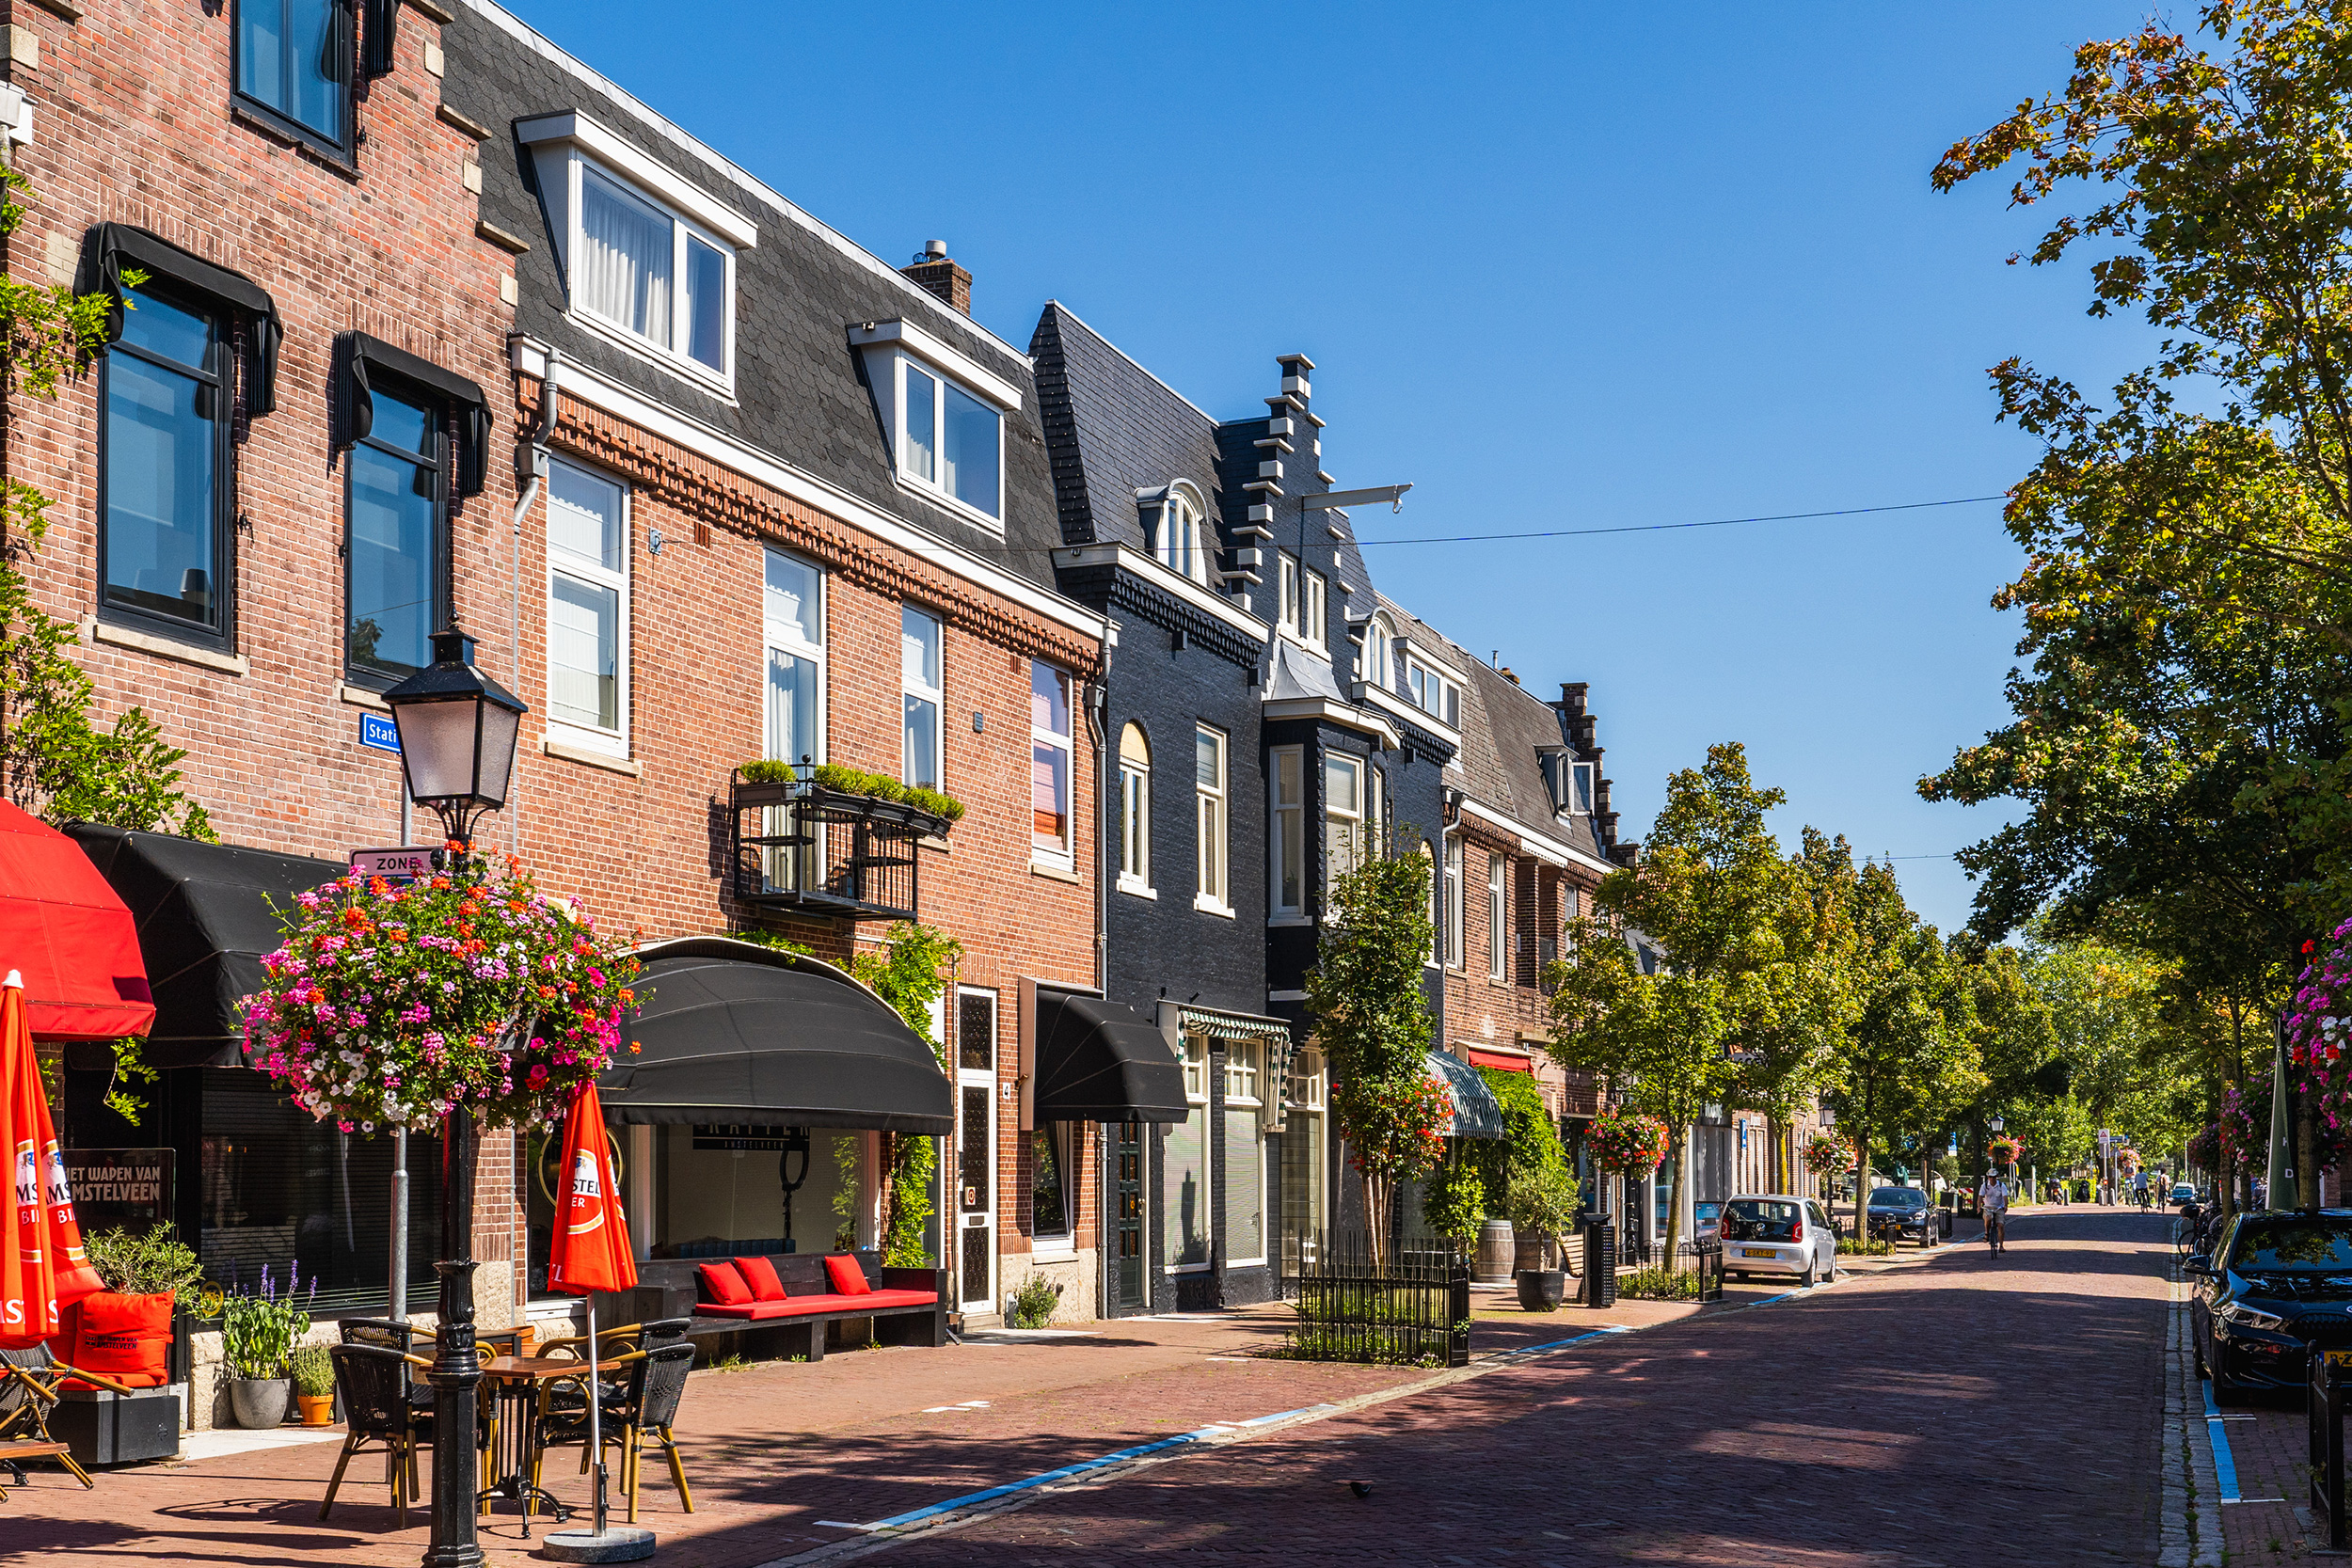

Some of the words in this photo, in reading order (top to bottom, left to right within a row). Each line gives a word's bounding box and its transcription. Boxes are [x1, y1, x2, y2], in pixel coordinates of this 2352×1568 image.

[369, 723, 397, 743] Stati
[376, 857, 419, 870] ZONE
[87, 1166, 132, 1181] WAPEN
[135, 1166, 160, 1181] VAN
[96, 1340, 137, 1350] AMSTELVEEN
